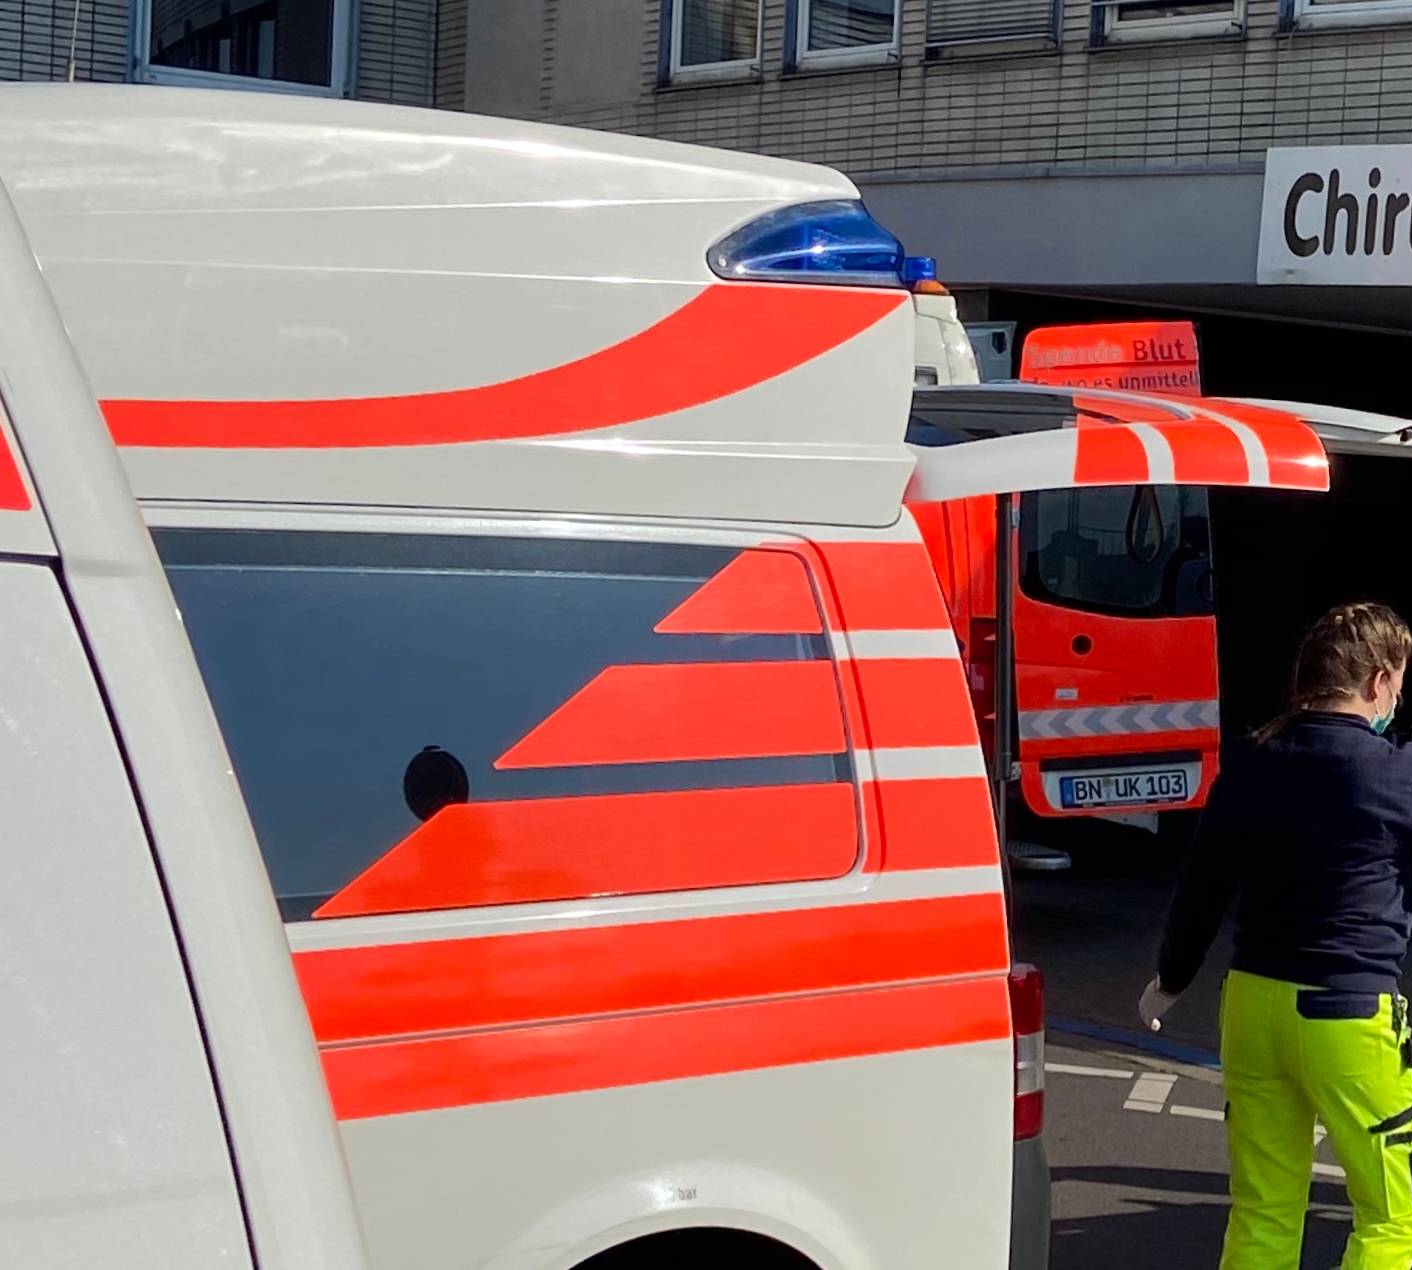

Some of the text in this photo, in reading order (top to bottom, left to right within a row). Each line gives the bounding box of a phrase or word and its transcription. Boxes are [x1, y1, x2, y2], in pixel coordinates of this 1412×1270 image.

[1132, 338, 1187, 362] Blut
[1075, 774, 1184, 801] BN UK 103
